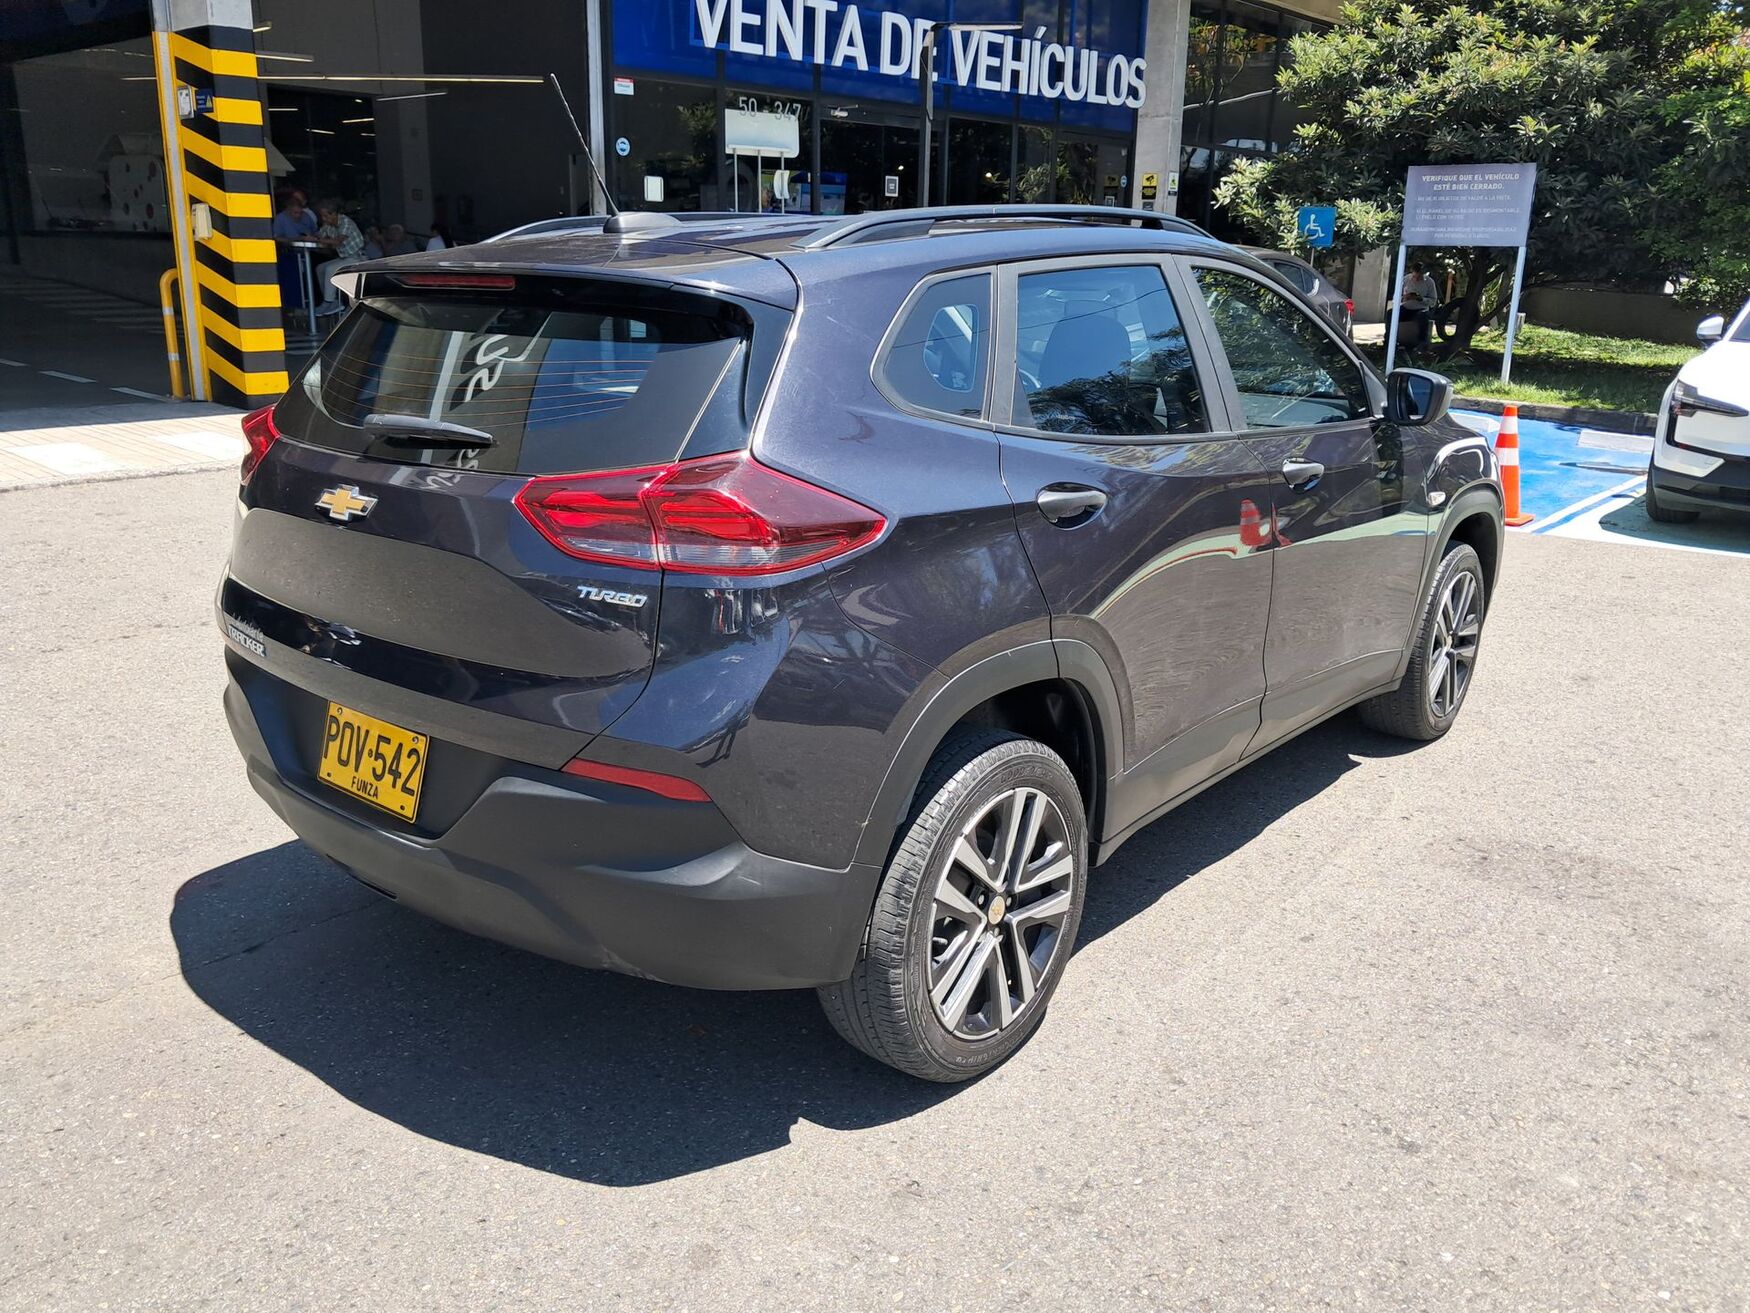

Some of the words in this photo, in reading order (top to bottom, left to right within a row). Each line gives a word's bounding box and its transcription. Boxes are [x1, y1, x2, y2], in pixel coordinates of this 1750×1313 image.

[696, 0, 869, 72] VENTA
[951, 25, 1148, 109] VEHÍCULOS
[1485, 172, 1520, 180] VEHÍCULO
[577, 585, 649, 608] TURBO
[351, 776, 379, 800] FUNZA
